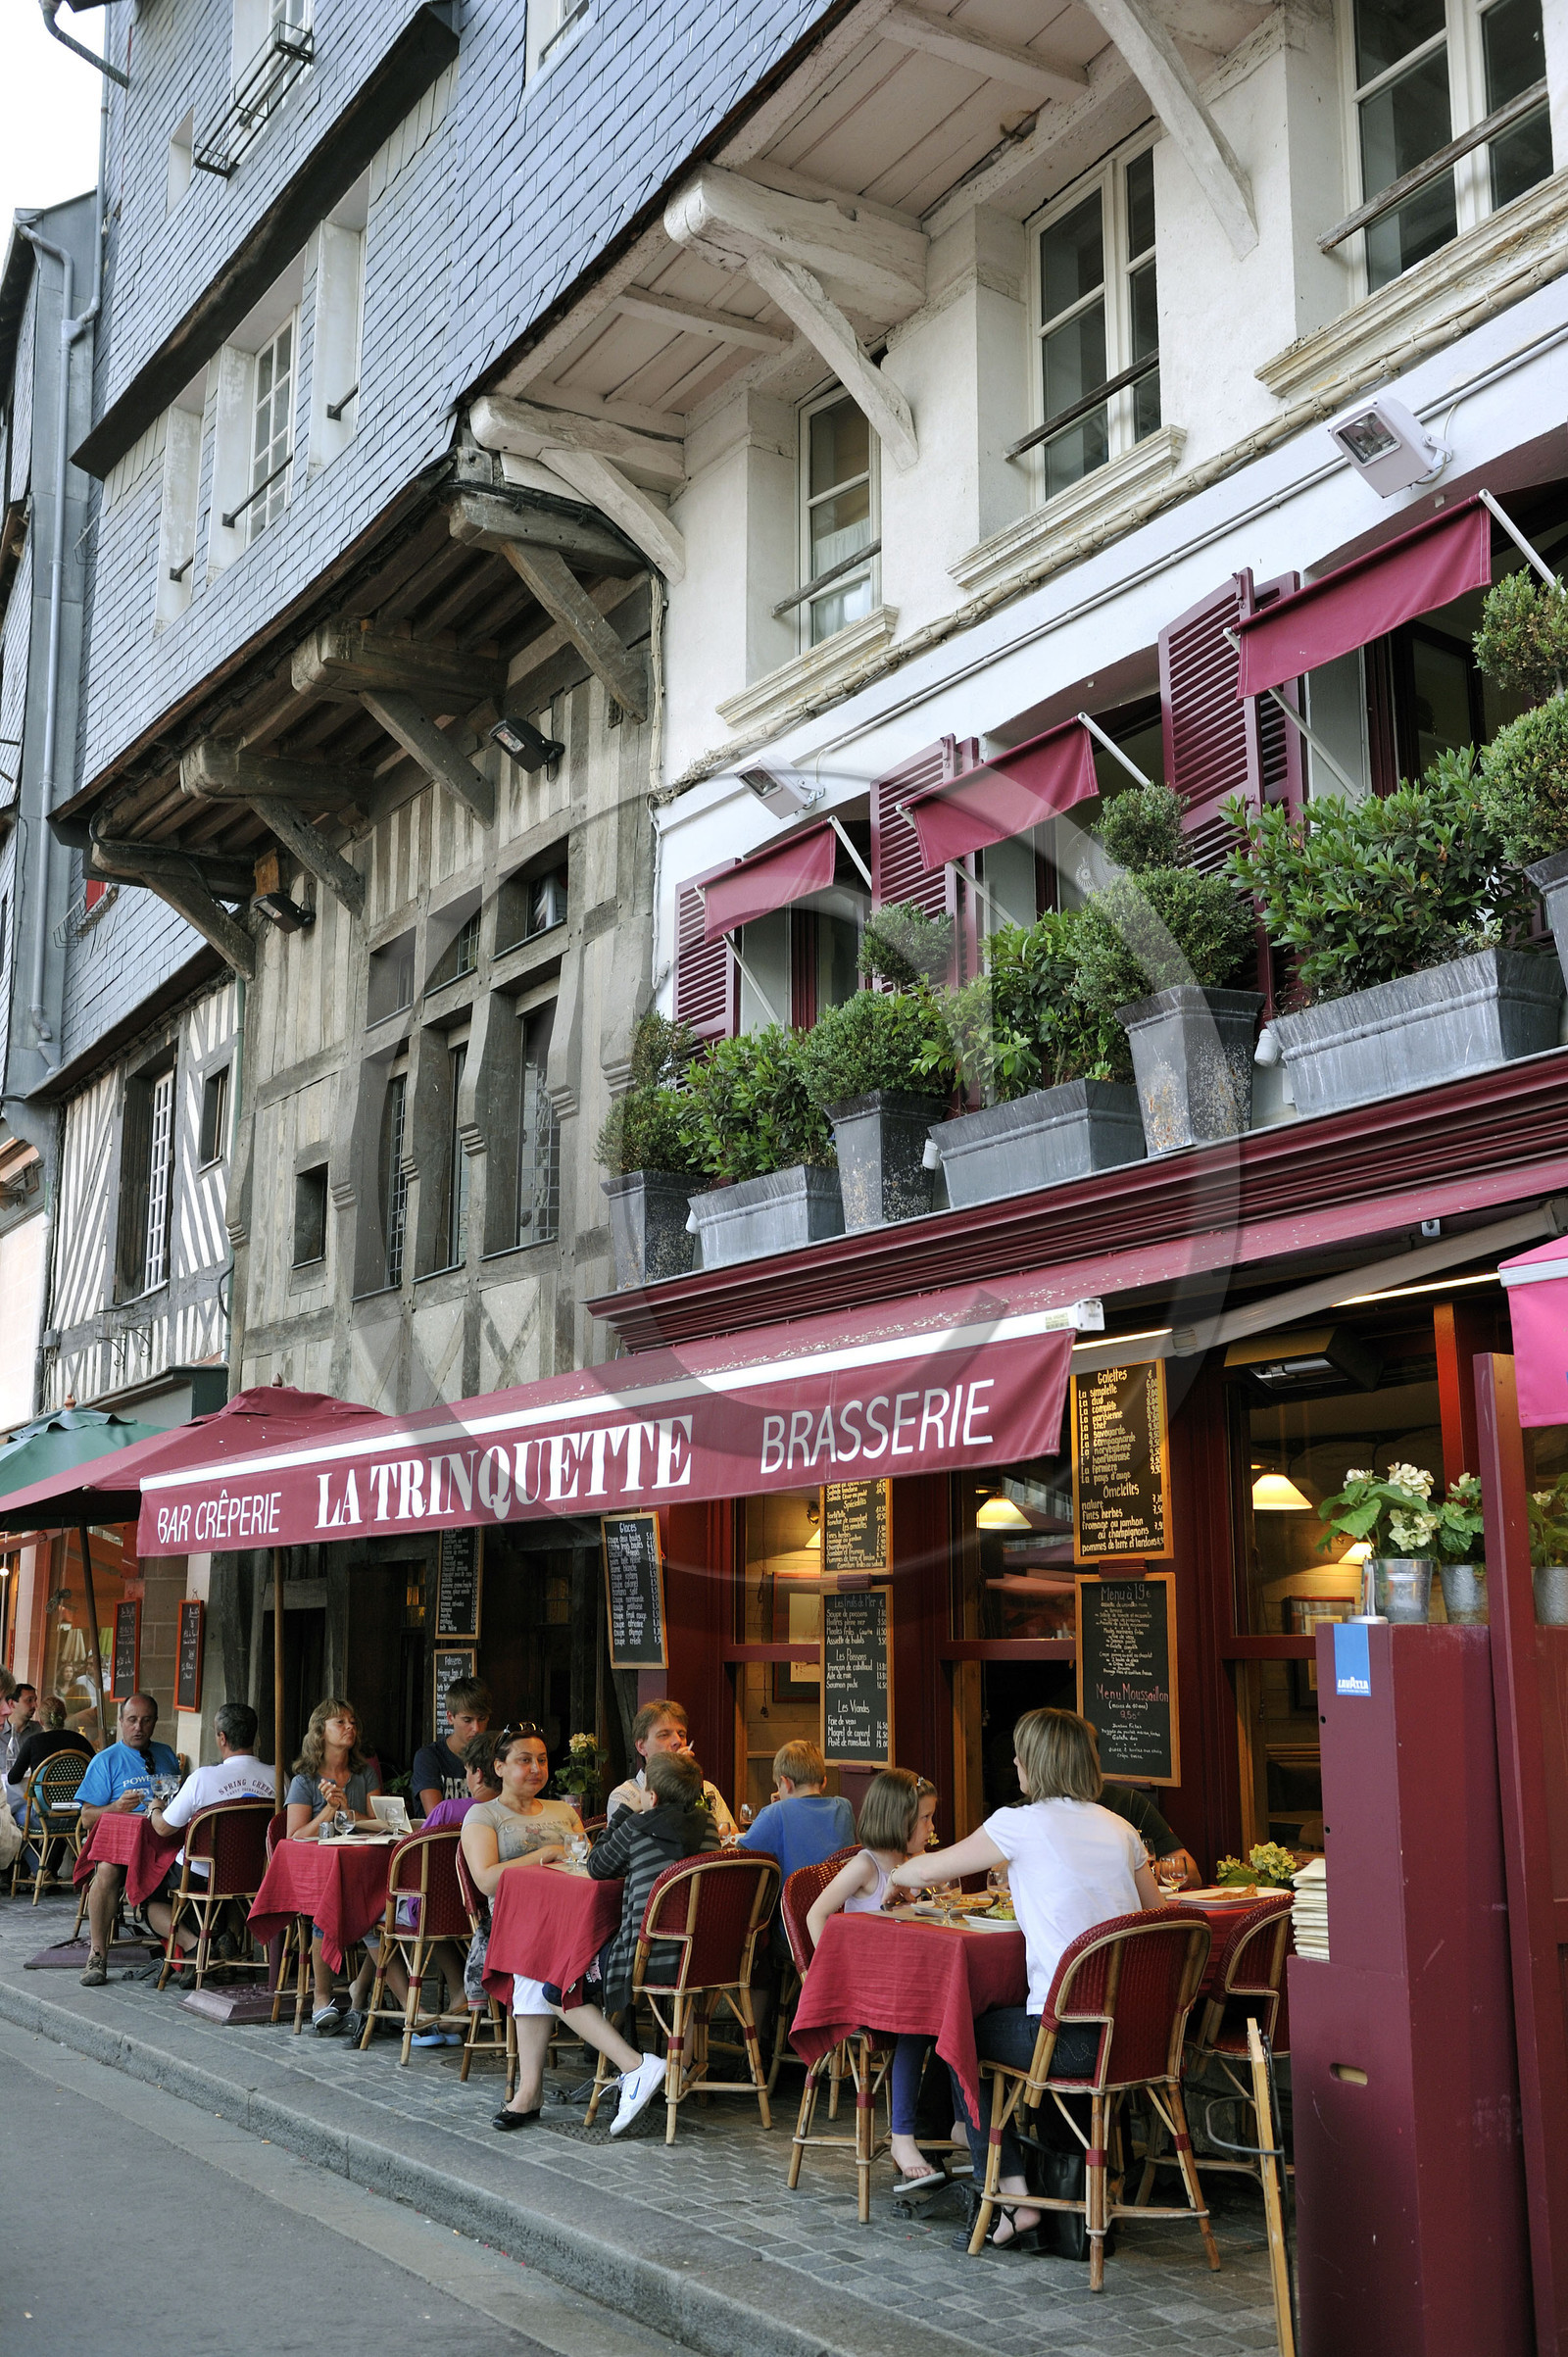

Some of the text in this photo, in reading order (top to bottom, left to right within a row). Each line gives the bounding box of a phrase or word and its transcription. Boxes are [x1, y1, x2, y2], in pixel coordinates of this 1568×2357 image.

[1098, 1368, 1127, 1385] Galettes
[1078, 1390, 1087, 1399] La
[1079, 1399, 1088, 1408] La
[1080, 1407, 1089, 1416] La
[1080, 1415, 1089, 1424] La
[760, 1379, 994, 1474] BRASSERIE
[1080, 1424, 1089, 1433] La
[1081, 1432, 1089, 1441] La
[1081, 1441, 1090, 1449] La
[1081, 1449, 1090, 1457] La
[315, 1414, 693, 1529] LA TRINQUETTE
[1081, 1475, 1090, 1484] La
[1103, 1482, 1140, 1498] Omelettes
[1082, 1498, 1104, 1510] nature
[158, 1490, 281, 1544] BAR CRÊPERIE
[1102, 1507, 1123, 1520] herbes
[619, 1522, 637, 1534] Glaces
[1120, 1515, 1144, 1529] jambon
[1108, 1527, 1150, 1540] champignons
[1082, 1541, 1107, 1555] pommes
[1108, 1540, 1115, 1549] de
[1101, 1587, 1124, 1601] Menu
[1127, 1586, 1132, 1600] à
[836, 1647, 867, 1661] Les Poissons
[1338, 1676, 1369, 1690] LAVAZZA
[1097, 1683, 1169, 1702] Menu Moussaillon
[838, 1698, 870, 1713] Les Viandes
[828, 1714, 838, 1725] Foie
[838, 1715, 844, 1725] de
[847, 1726, 853, 1737] de
[854, 1725, 870, 1738] canard
[219, 1779, 247, 1795] SPRING
